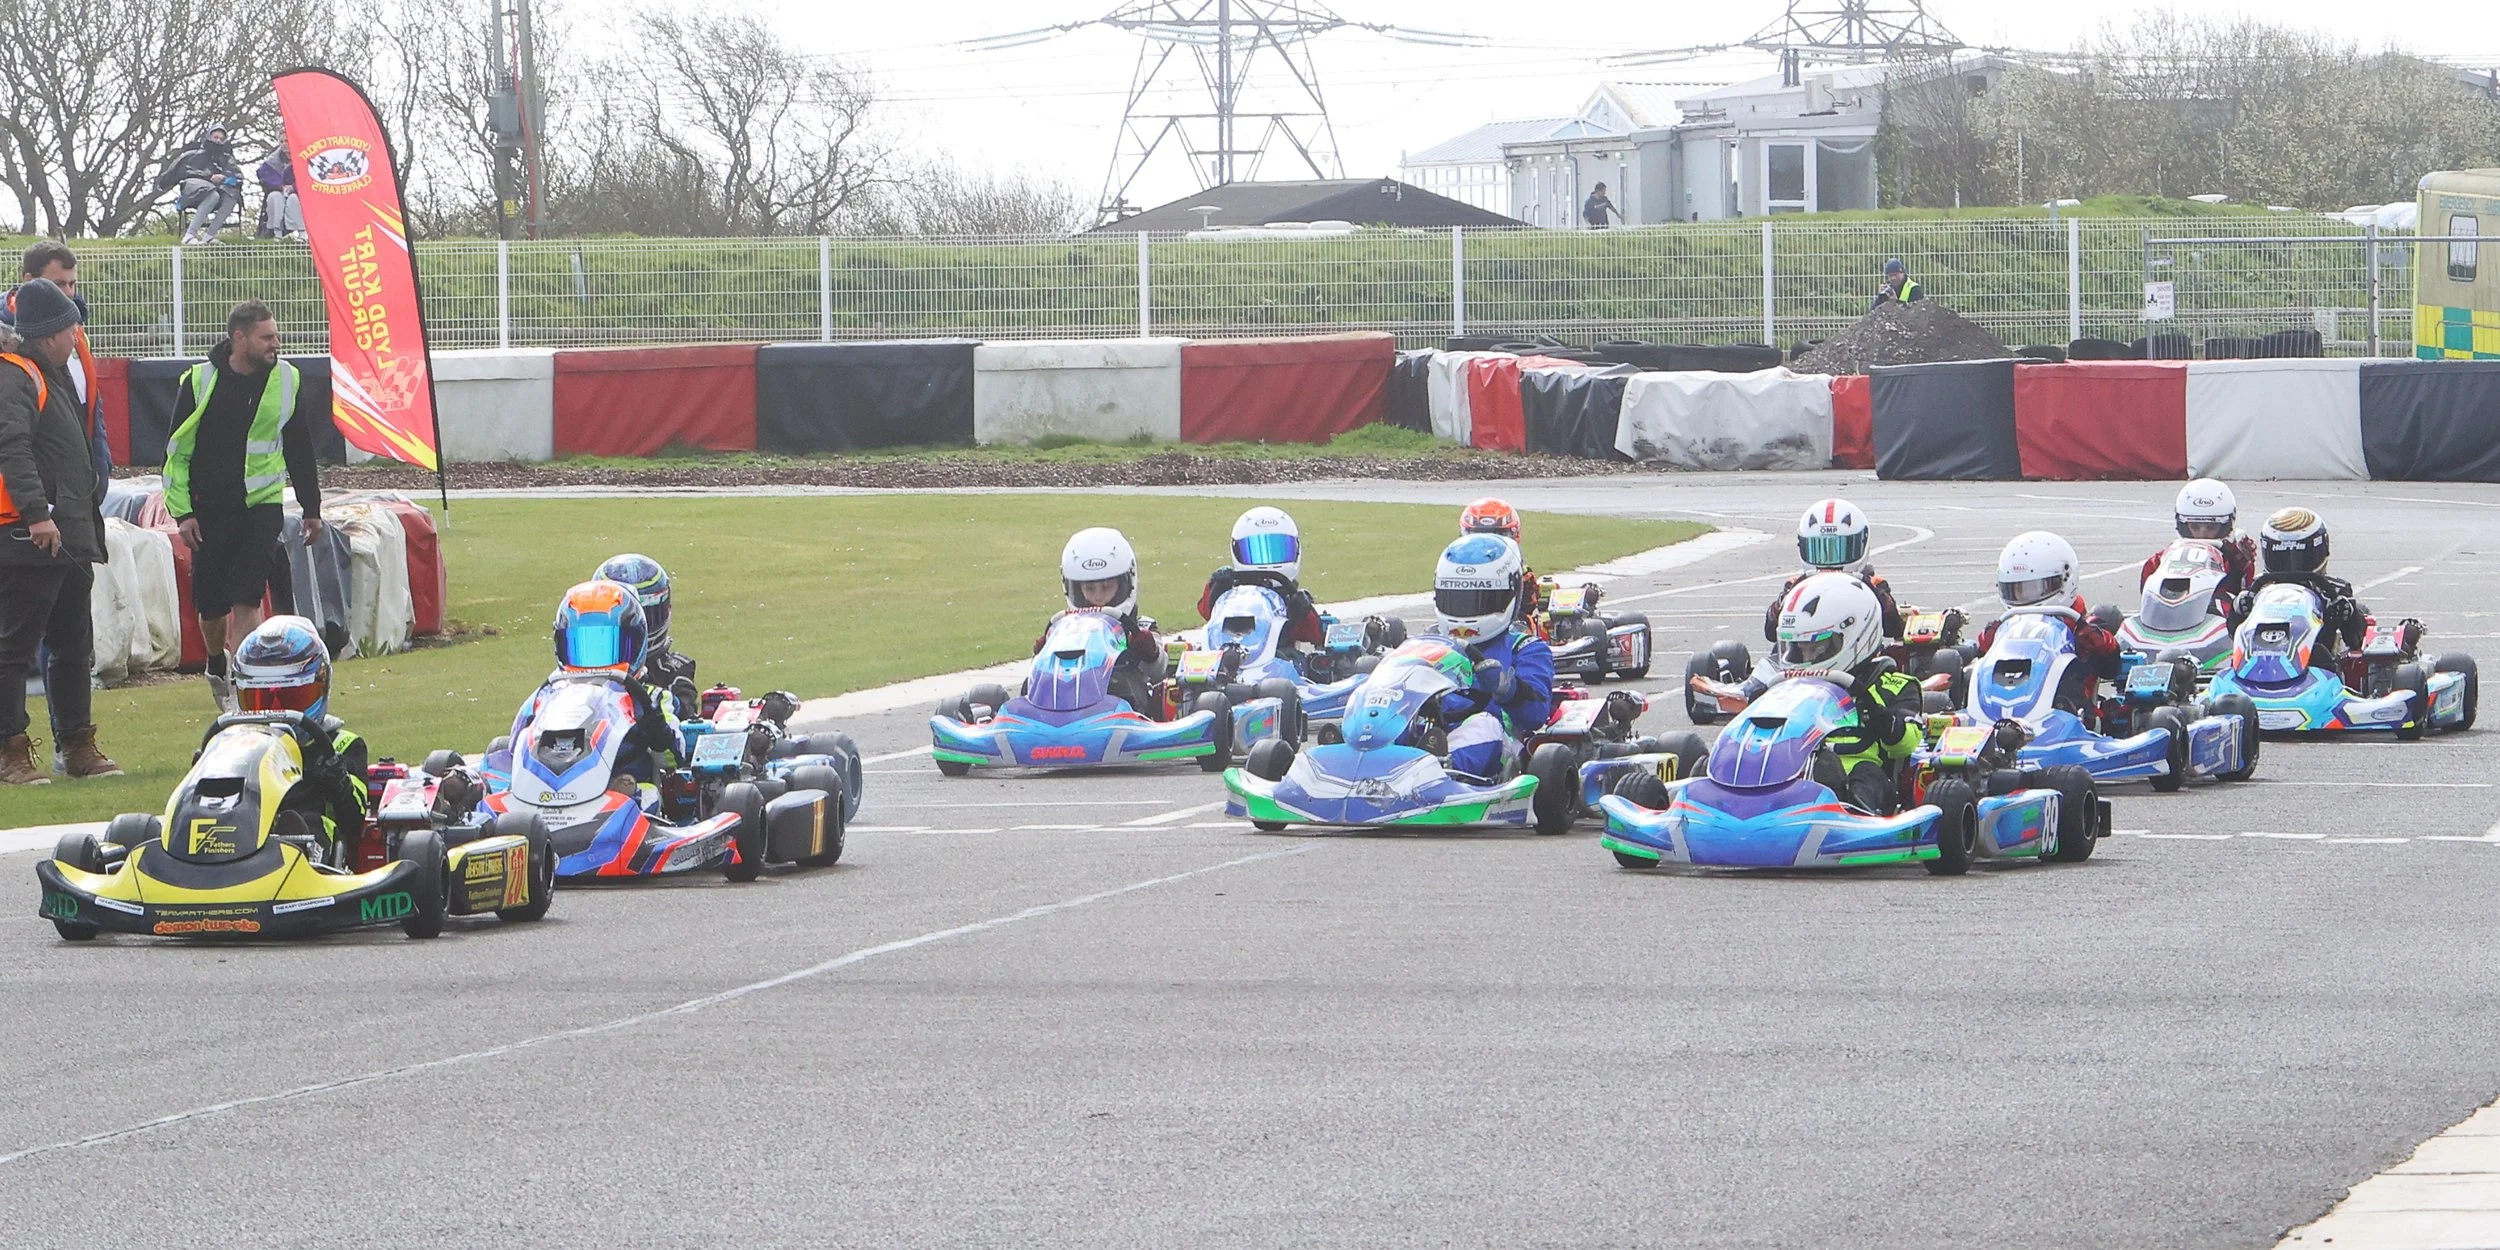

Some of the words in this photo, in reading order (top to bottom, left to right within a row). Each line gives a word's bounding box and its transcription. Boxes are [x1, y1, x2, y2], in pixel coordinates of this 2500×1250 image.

[1440, 580, 1492, 588] PETRONAS
[1783, 668, 1830, 678] WRIGHT
[2041, 795, 2059, 854] 89
[360, 891, 413, 921] MTD
[154, 908, 259, 916] TEAMFATHERS.COM
